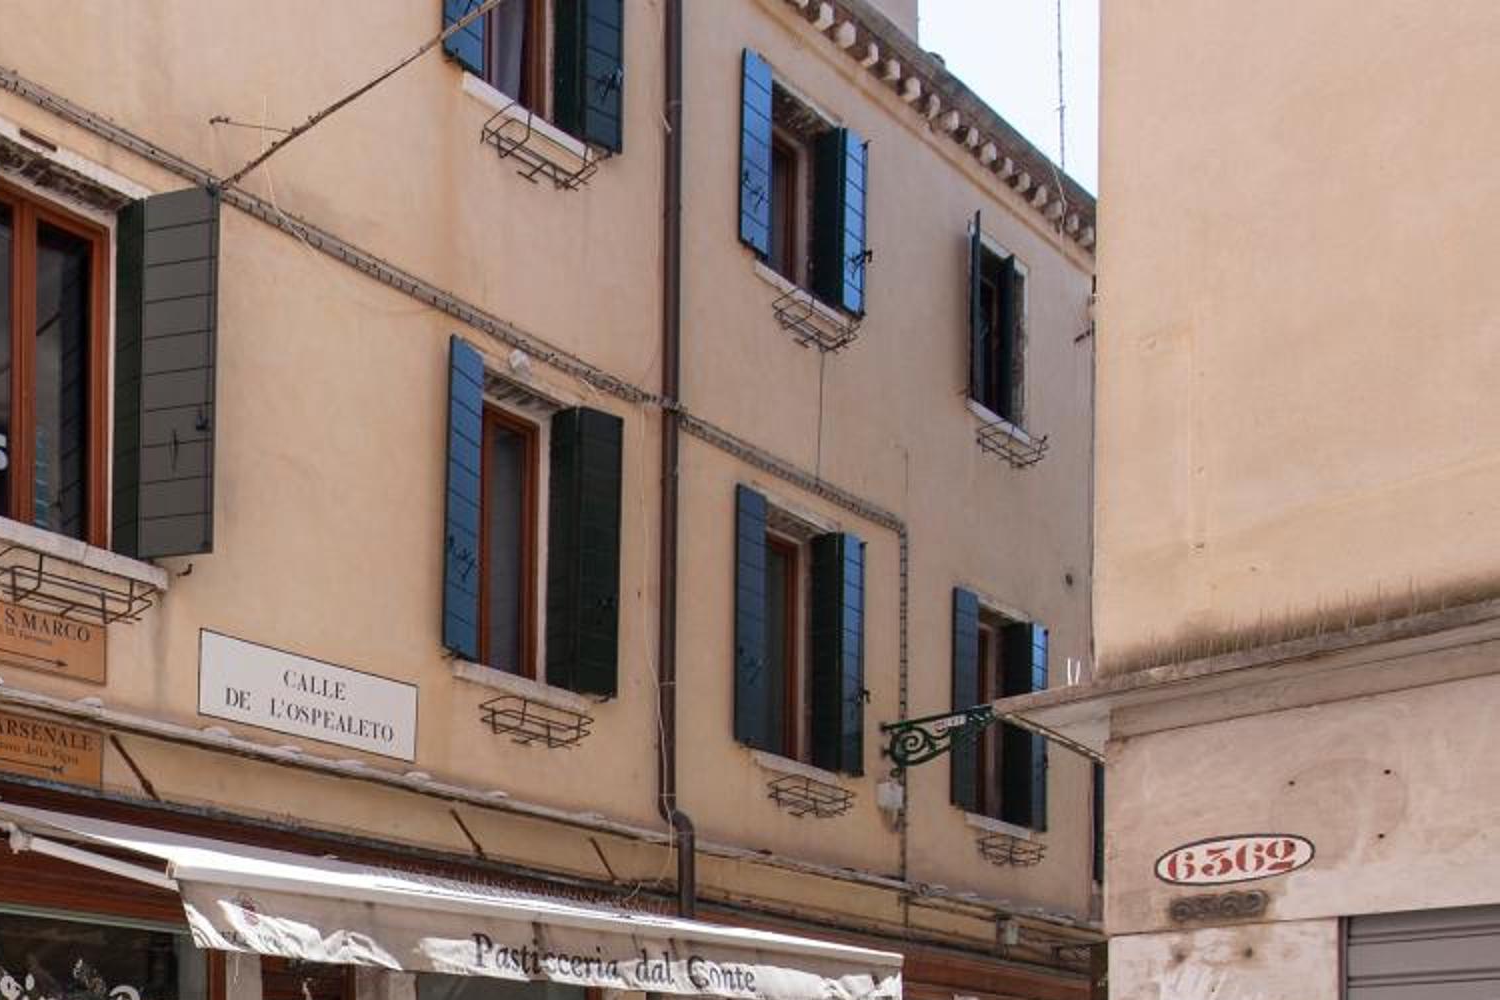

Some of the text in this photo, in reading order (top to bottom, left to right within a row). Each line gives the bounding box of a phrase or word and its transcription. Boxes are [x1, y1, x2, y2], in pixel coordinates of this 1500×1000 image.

[283, 669, 347, 701] CALLE
[225, 687, 395, 743] DE L'OSPEALETO
[1166, 839, 1297, 881] 6362
[471, 932, 757, 993] Pasticceria dal Conte
